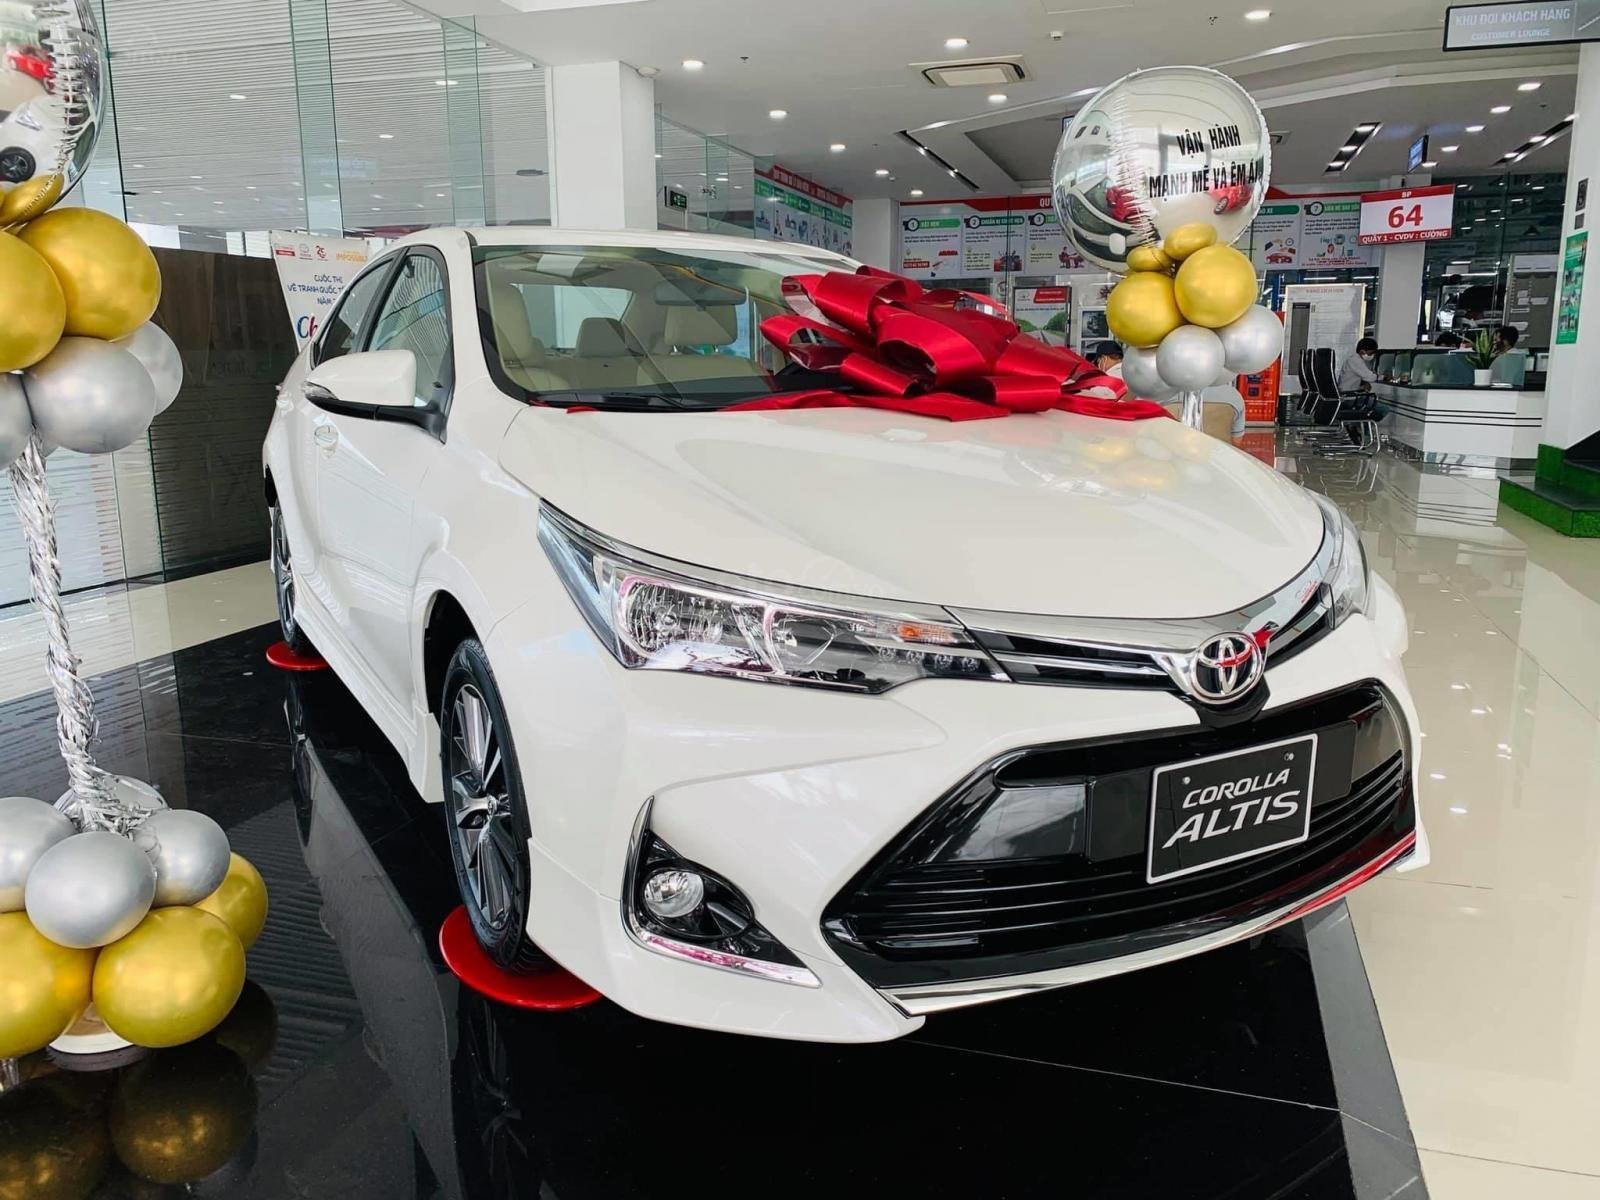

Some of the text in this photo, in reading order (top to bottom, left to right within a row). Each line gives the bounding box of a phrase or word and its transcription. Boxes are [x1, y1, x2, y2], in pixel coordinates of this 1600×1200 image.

[1455, 14, 1477, 26] KHU
[1472, 28, 1551, 41] CUSTOMER LOUNGE
[1177, 123, 1241, 159] VẬN HÀNH
[1149, 172, 1188, 202] MẠNH
[1192, 165, 1210, 193] MẼ
[1213, 162, 1227, 190] VÀ
[1230, 160, 1246, 187] ÊM
[1039, 197, 1052, 208] QU
[1388, 204, 1423, 228] 64
[298, 284, 319, 293] TRANH
[1182, 768, 1290, 809] COROLLA
[1162, 790, 1300, 849] ALTIS
